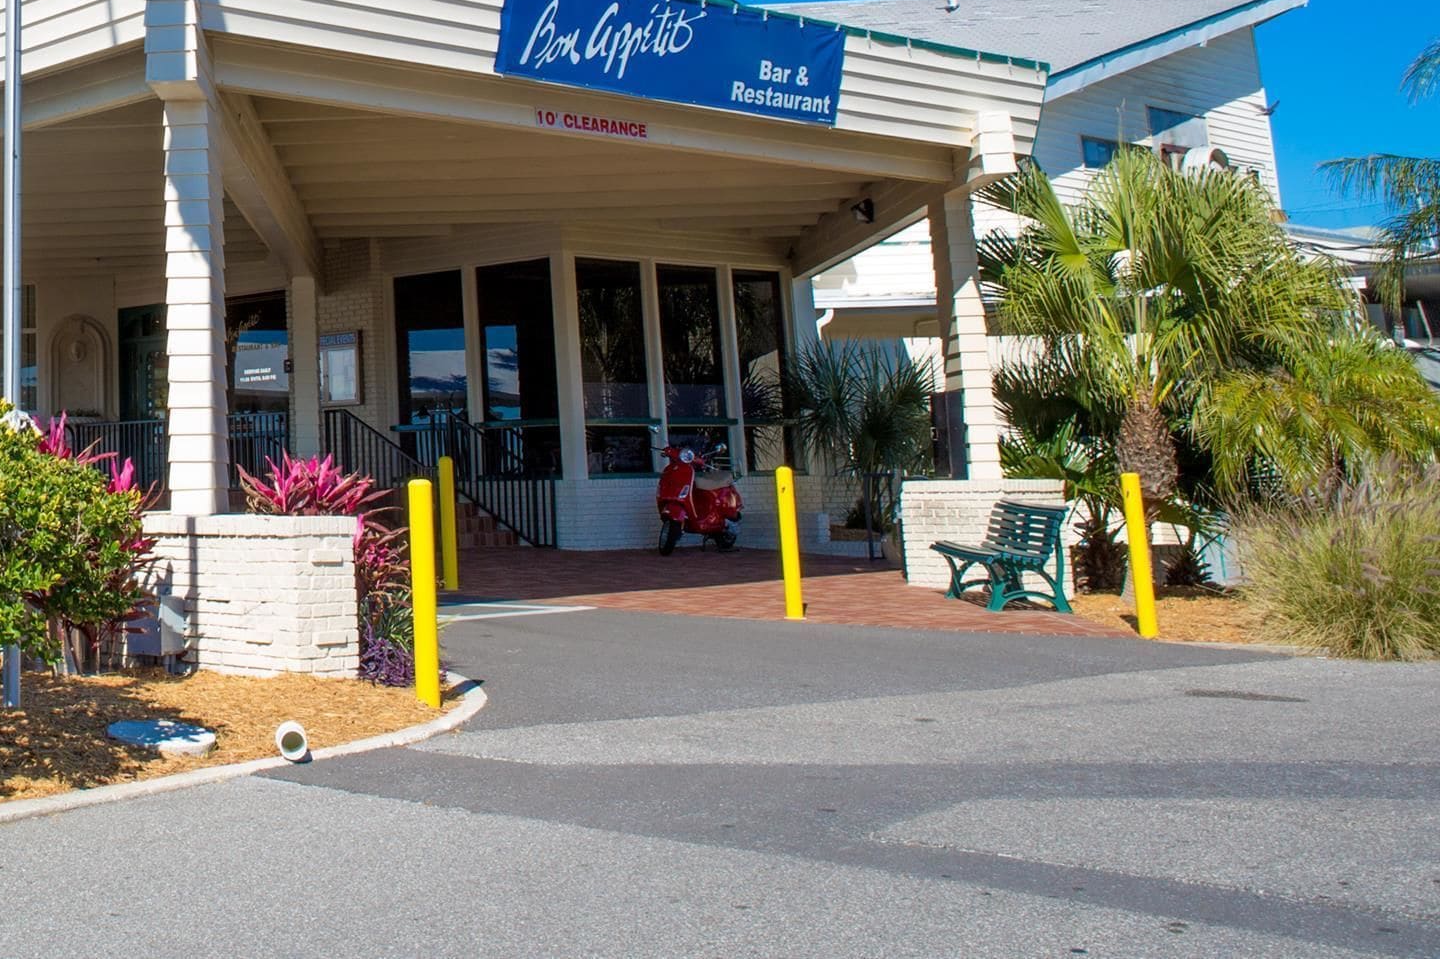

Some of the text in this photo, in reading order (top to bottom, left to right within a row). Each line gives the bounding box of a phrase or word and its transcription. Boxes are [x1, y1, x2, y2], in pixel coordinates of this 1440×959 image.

[584, 1, 707, 80] Appétit
[759, 60, 809, 87] Bar &
[731, 80, 831, 114] Restaurant
[563, 113, 648, 138] CLEARANCE
